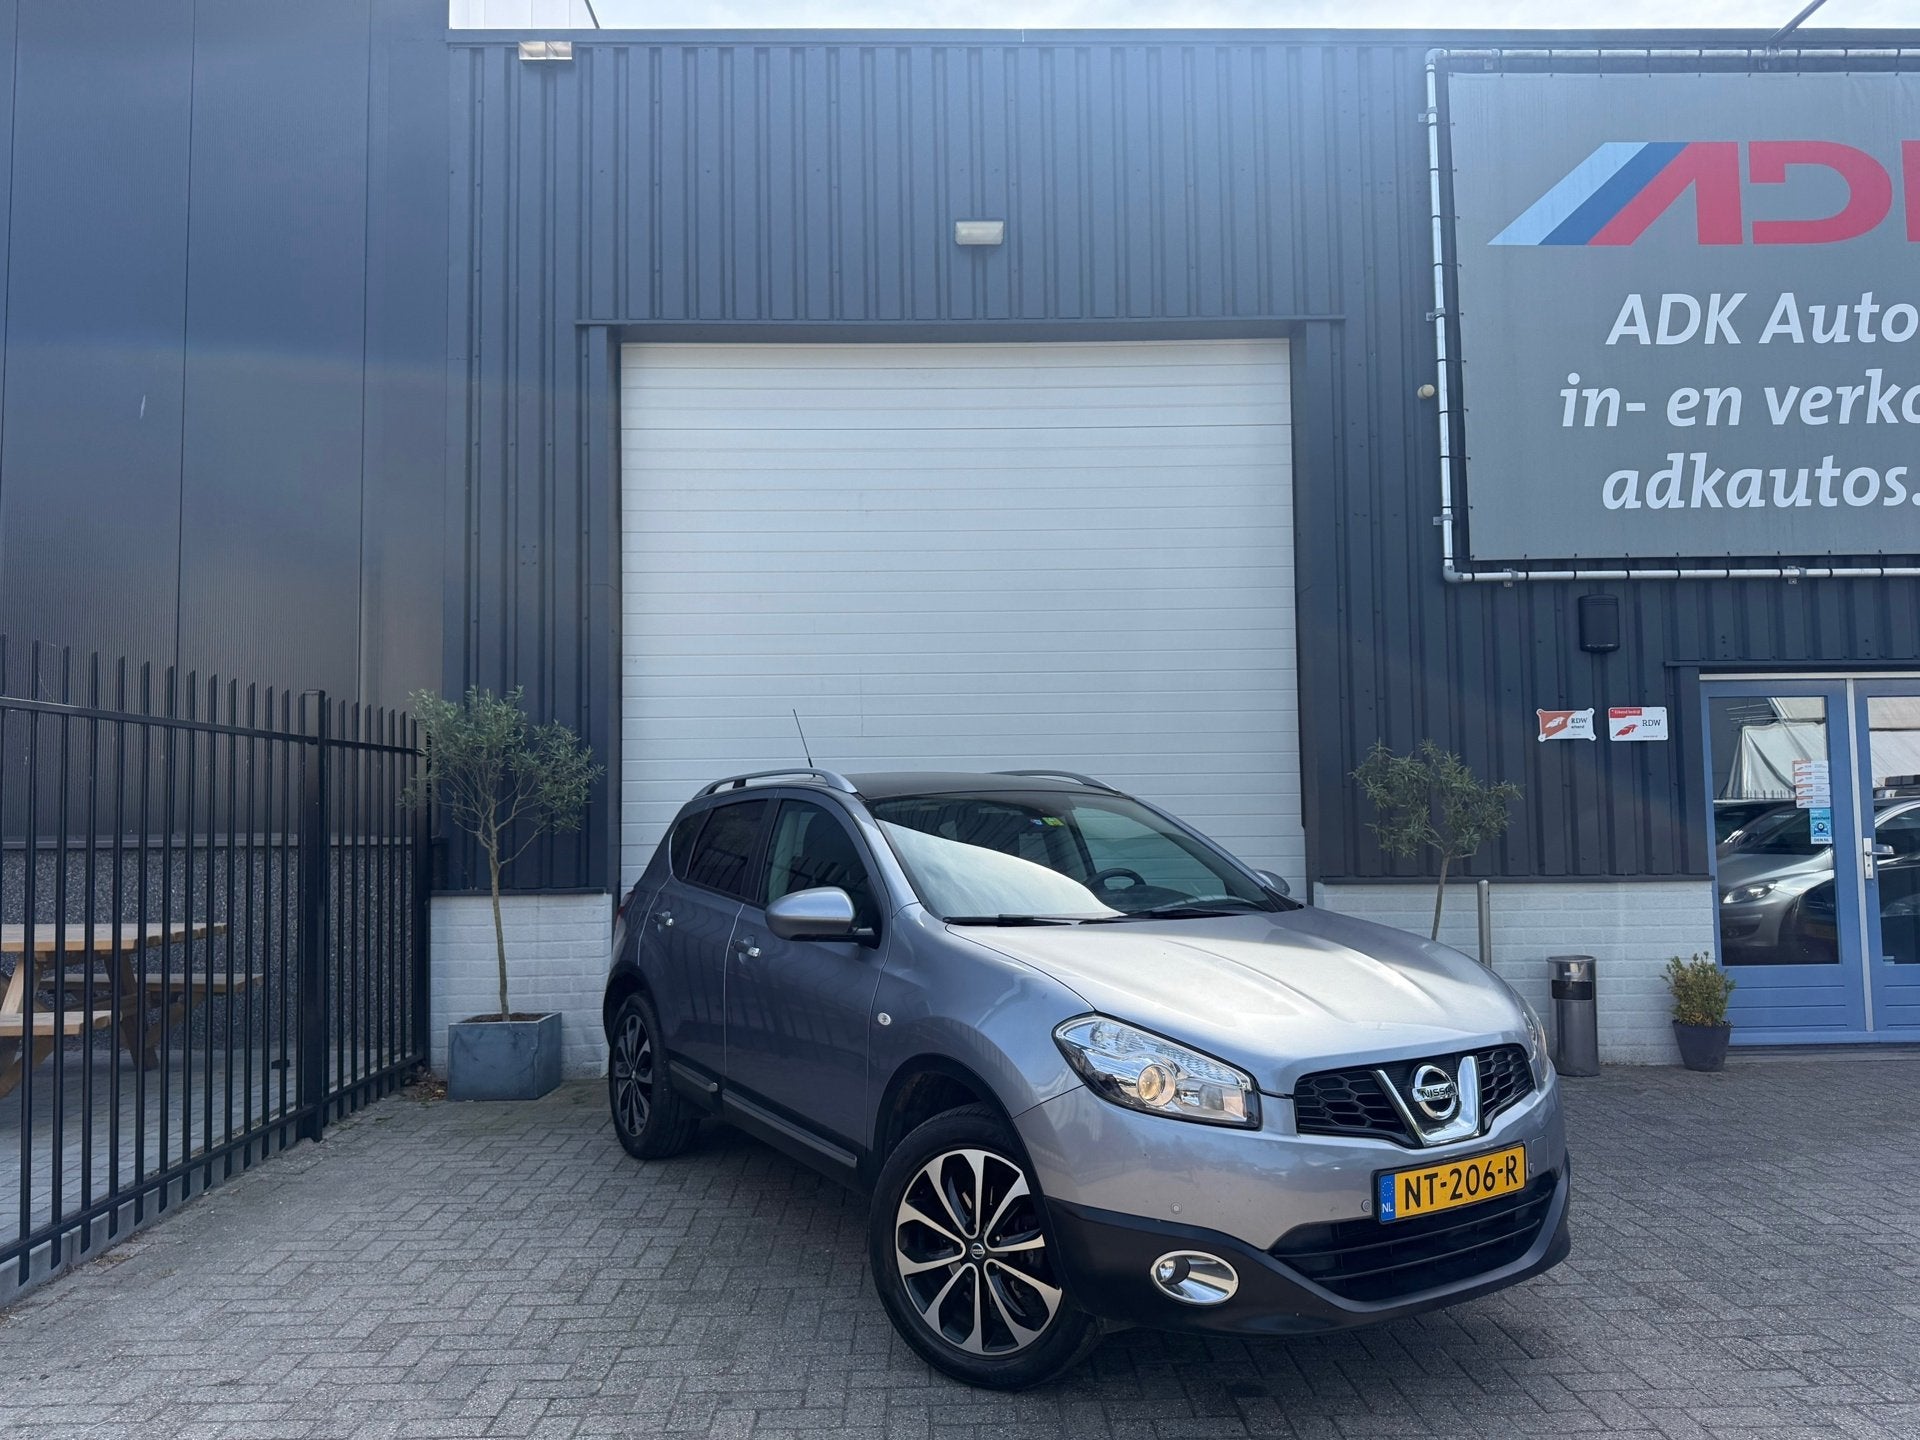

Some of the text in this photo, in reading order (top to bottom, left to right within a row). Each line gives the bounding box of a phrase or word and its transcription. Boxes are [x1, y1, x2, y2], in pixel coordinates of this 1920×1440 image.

[1605, 291, 1920, 345] ADK Auto
[1559, 372, 1646, 427] in-
[1666, 386, 1743, 427] en
[1602, 452, 1920, 510] adkautos.
[1642, 719, 1661, 727] RDW
[1382, 1202, 1394, 1214] NL
[1404, 1154, 1518, 1211] NT-206-R
